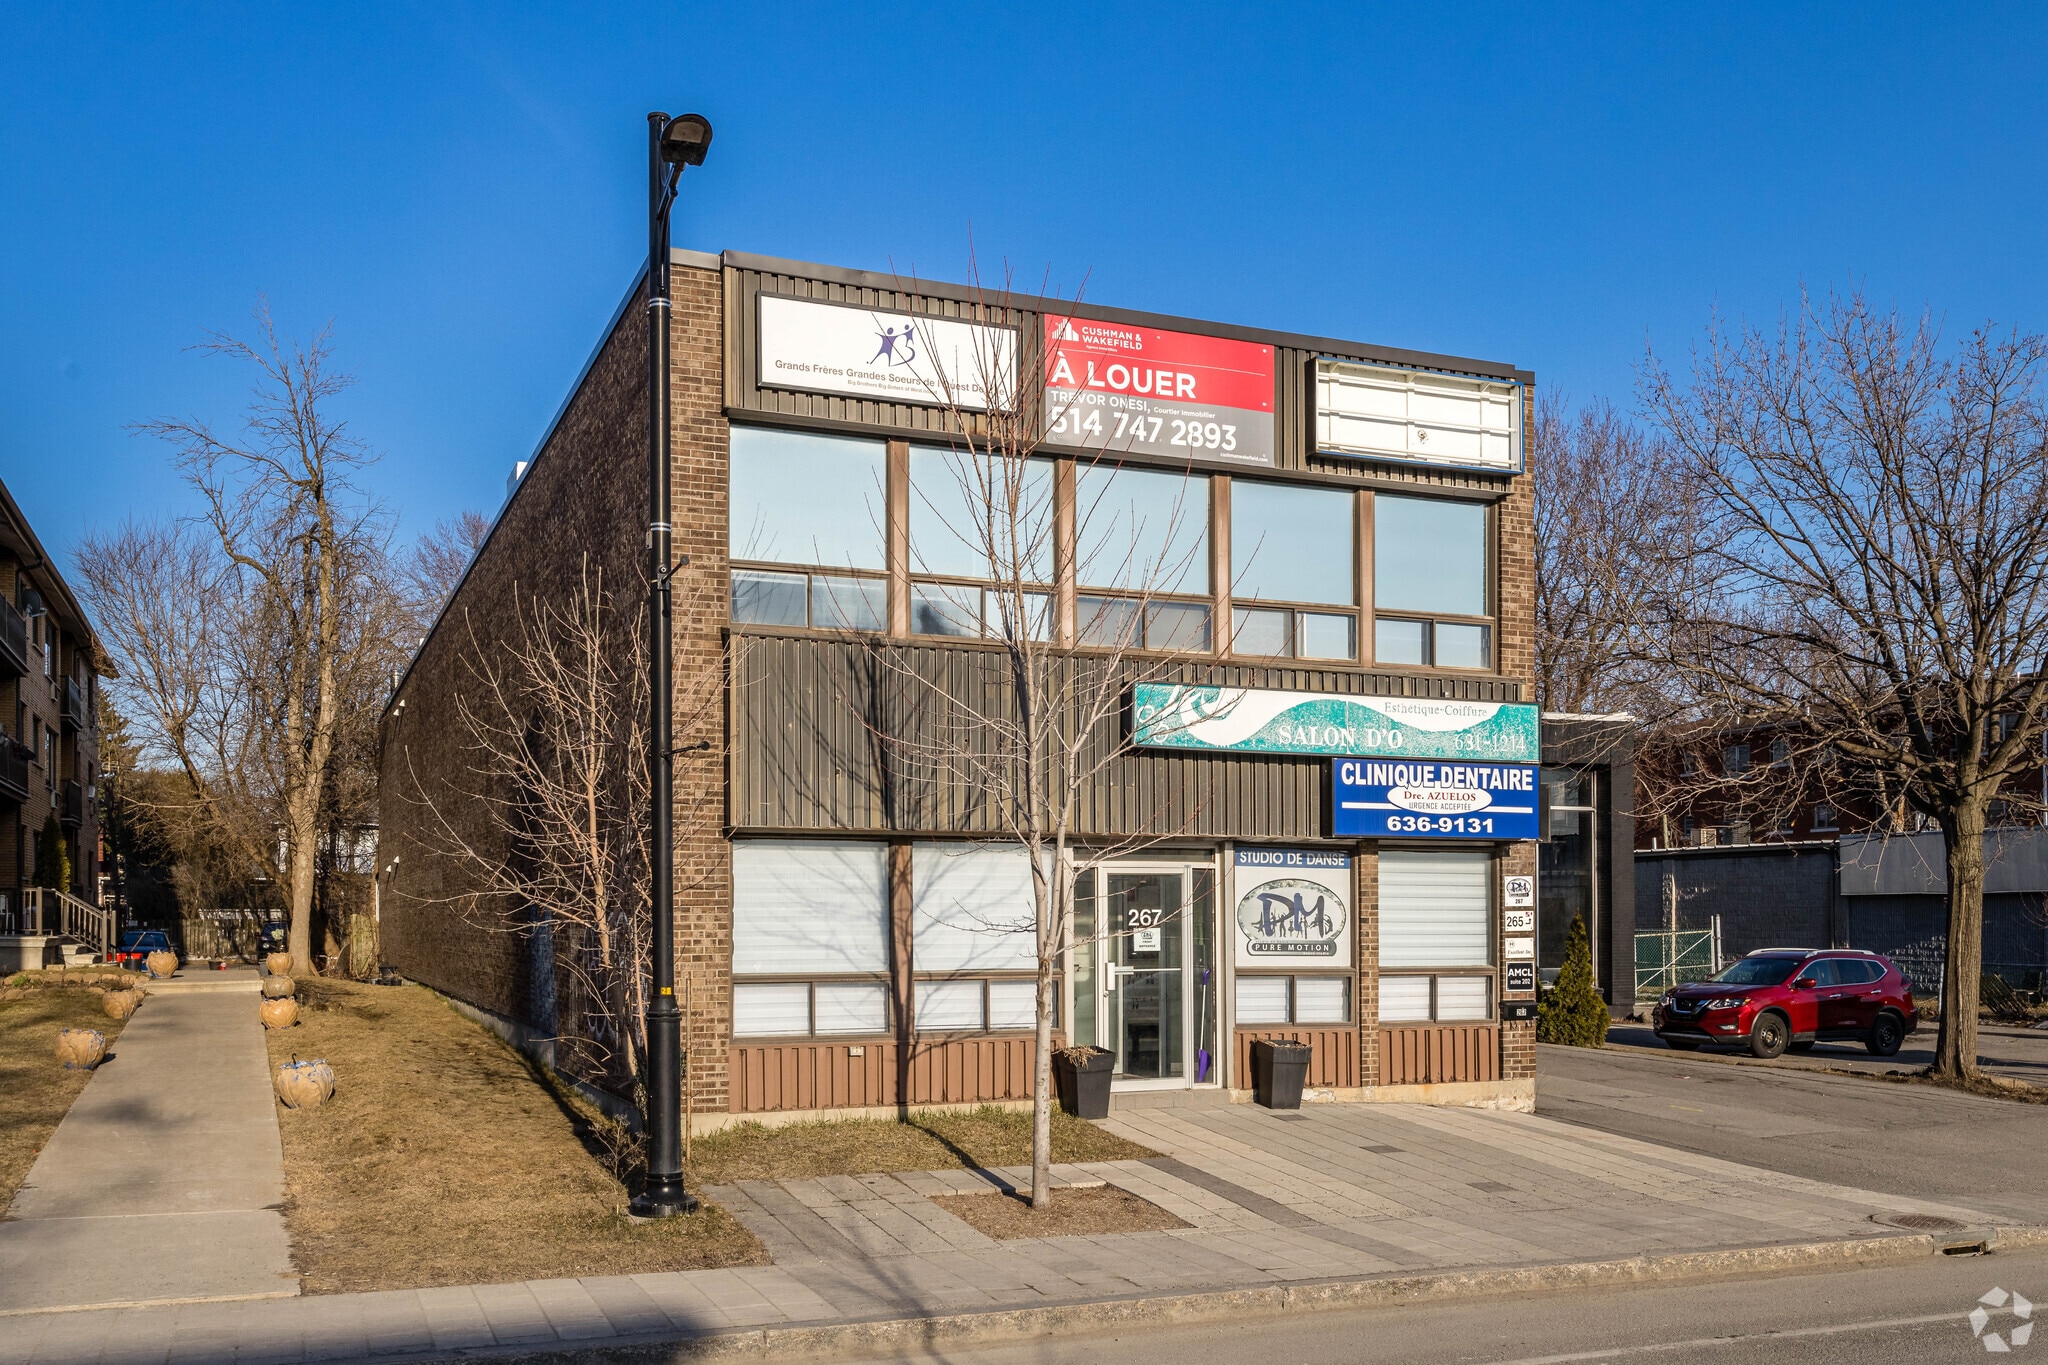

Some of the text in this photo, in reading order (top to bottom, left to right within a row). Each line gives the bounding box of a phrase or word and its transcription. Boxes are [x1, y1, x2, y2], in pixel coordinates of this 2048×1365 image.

[1081, 326, 1142, 342] CUSHMAN &
[1081, 334, 1143, 350] WAKEFIELD
[775, 359, 810, 373] Grands
[813, 363, 843, 377] Frères
[846, 367, 886, 382] Grandes
[889, 373, 921, 386] Soeurs
[1051, 351, 1197, 399] À LOUER
[857, 380, 877, 388] Brothers
[1051, 390, 1106, 407] TREVOR
[1153, 406, 1180, 417] Courtier
[1051, 406, 1237, 451] 514 747 2893
[1384, 702, 1487, 717] Esthétique-Coiffure
[1279, 725, 1356, 747] SALON
[1455, 733, 1525, 752] 631-1214
[1341, 762, 1534, 791] CLINIQUE DENTAIRE
[1404, 790, 1476, 802] Dre. AZUELOS
[1409, 802, 1472, 811] URGENCE ACCEPTÉE
[1386, 815, 1493, 833] 636-9131
[1240, 851, 1345, 866] STUDIO DE DANSE
[1128, 908, 1162, 926] 267
[1506, 916, 1524, 927] 265
[1508, 968, 1533, 977] AMCL
